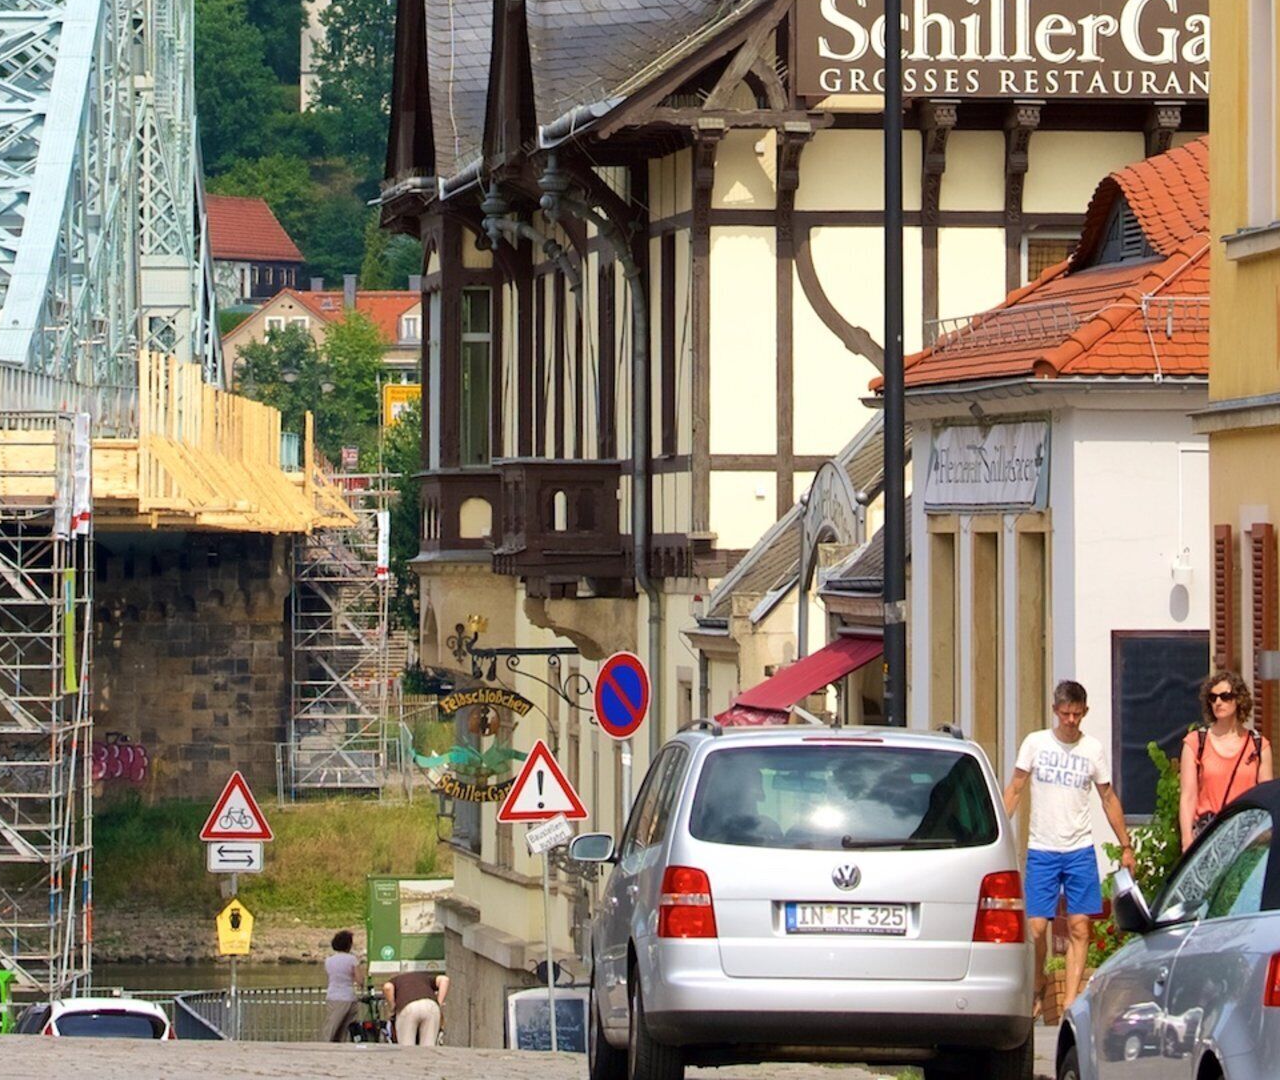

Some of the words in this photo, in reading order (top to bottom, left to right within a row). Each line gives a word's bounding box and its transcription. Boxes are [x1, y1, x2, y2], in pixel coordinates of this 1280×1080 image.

[999, 69, 1211, 95] RESTAURAN
[1038, 749, 1090, 774] SOUTH
[800, 906, 824, 925] IN
[837, 906, 862, 926] RF
[868, 907, 904, 926] 325
